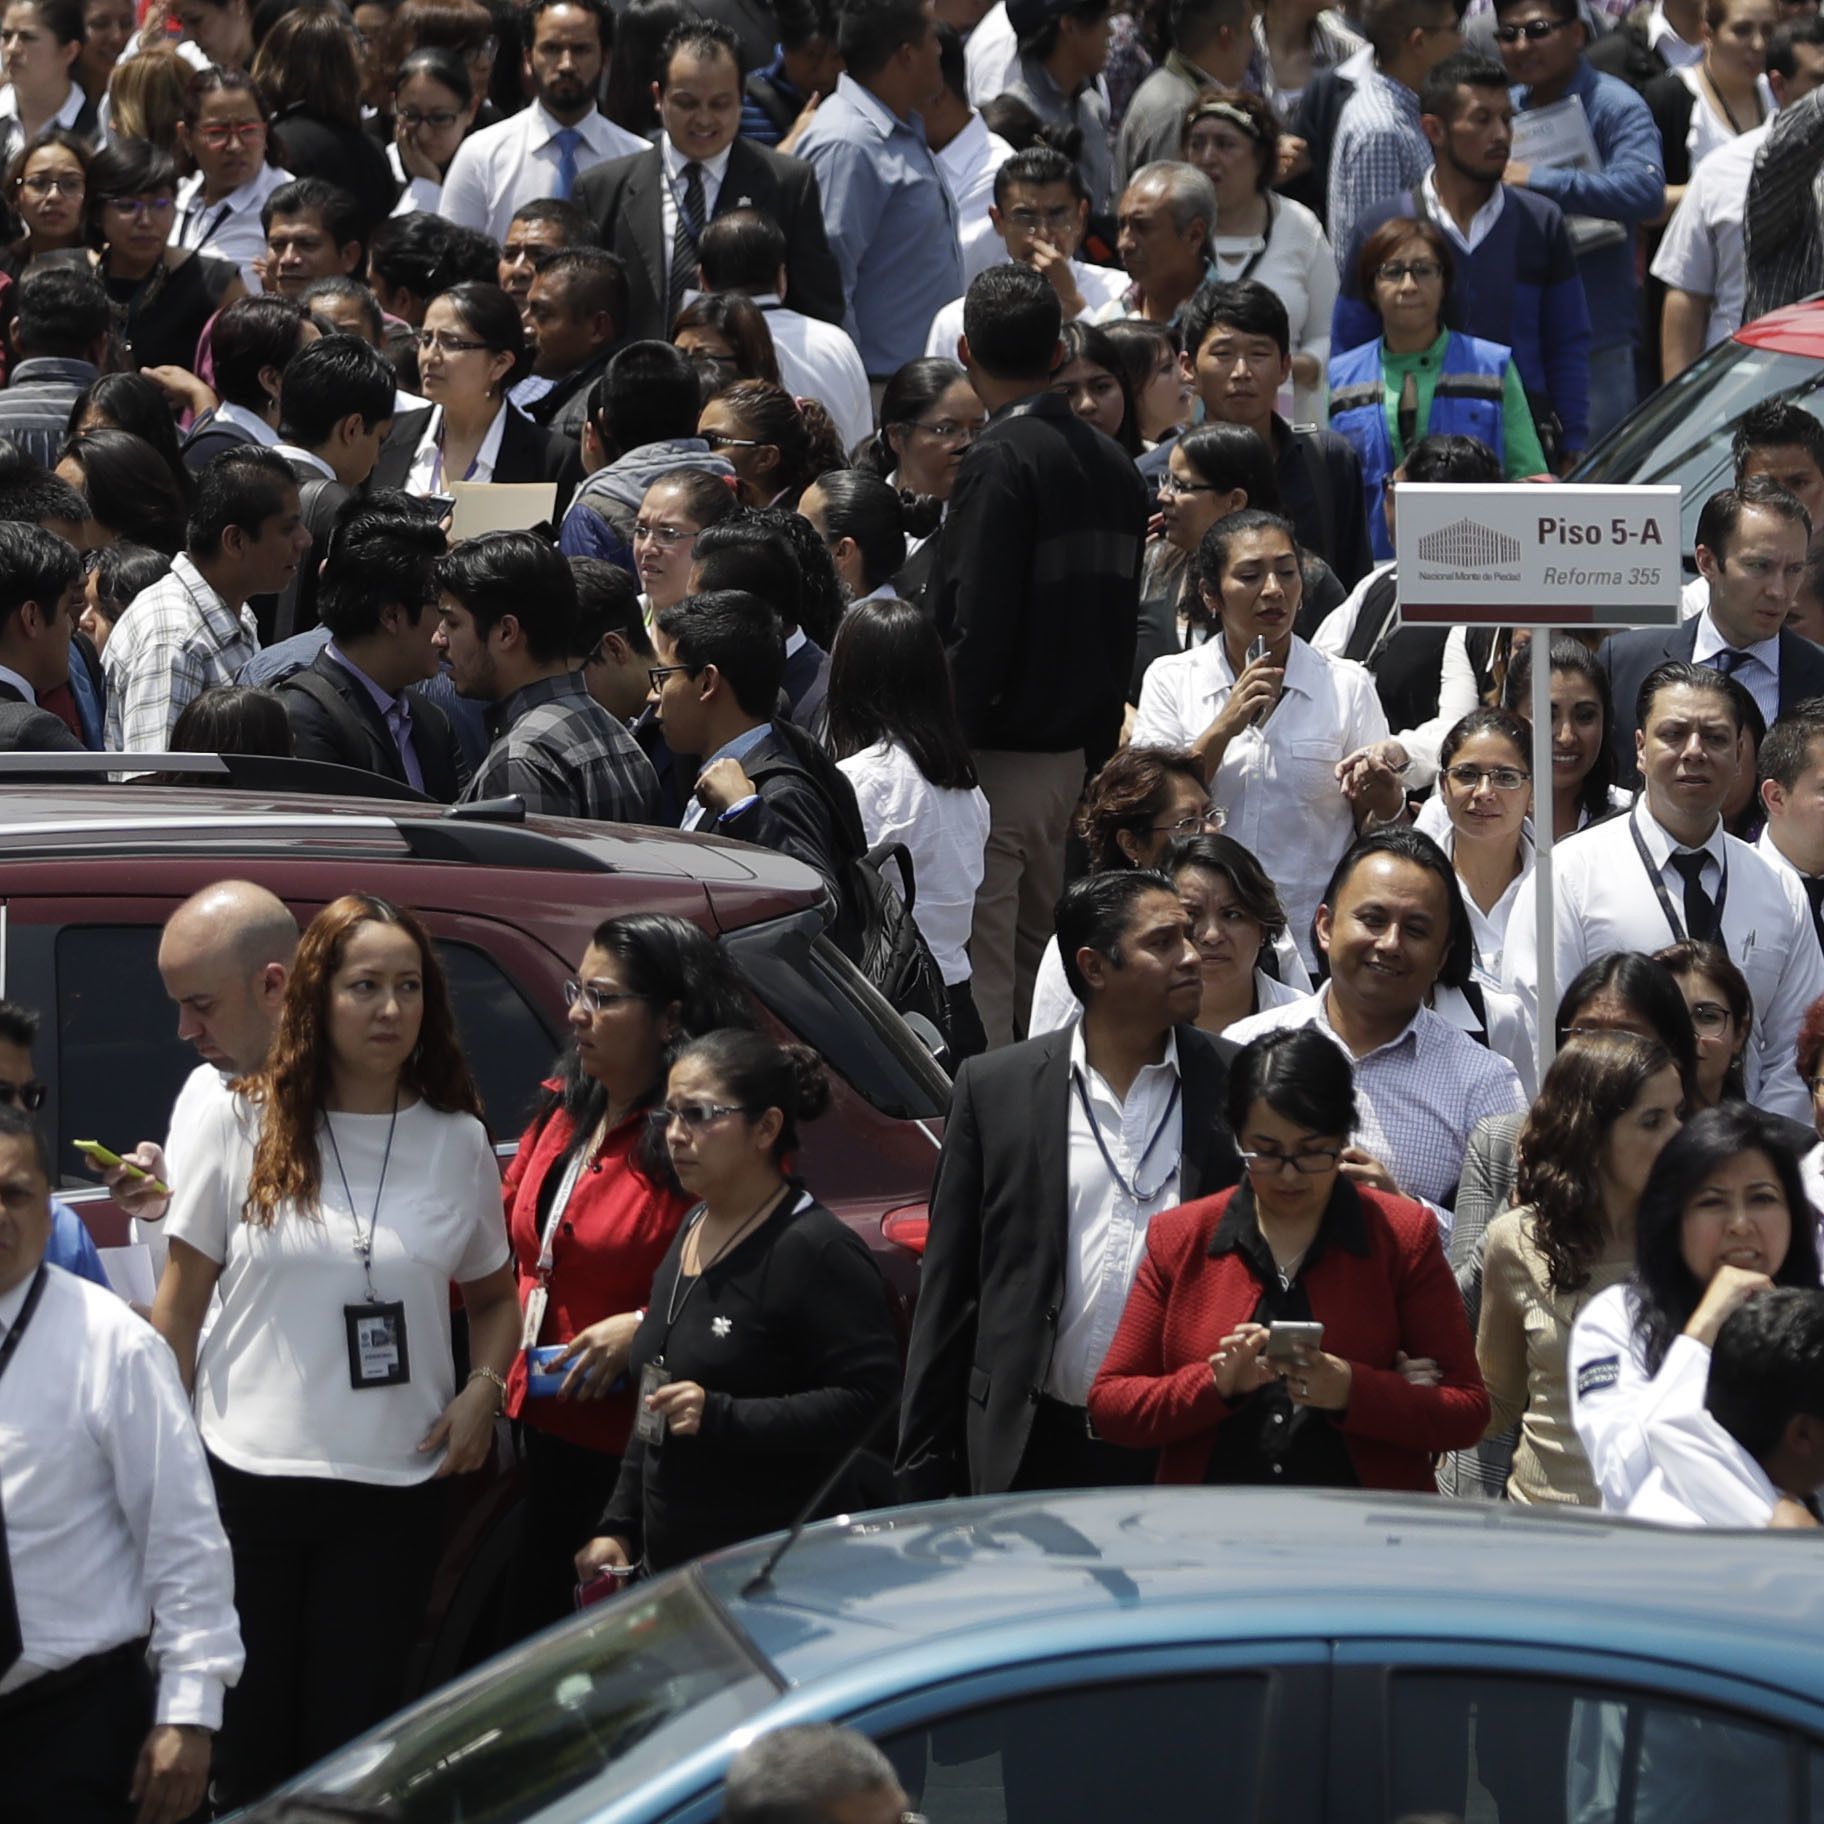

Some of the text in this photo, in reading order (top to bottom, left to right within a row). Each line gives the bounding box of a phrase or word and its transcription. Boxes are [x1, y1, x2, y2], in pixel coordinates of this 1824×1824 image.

[1538, 517, 1663, 546] Piso 5-A
[1419, 571, 1455, 582] Nacional
[1455, 571, 1481, 582] Monte
[1493, 571, 1521, 582] Piedad
[1543, 567, 1661, 586] Reforma 355
